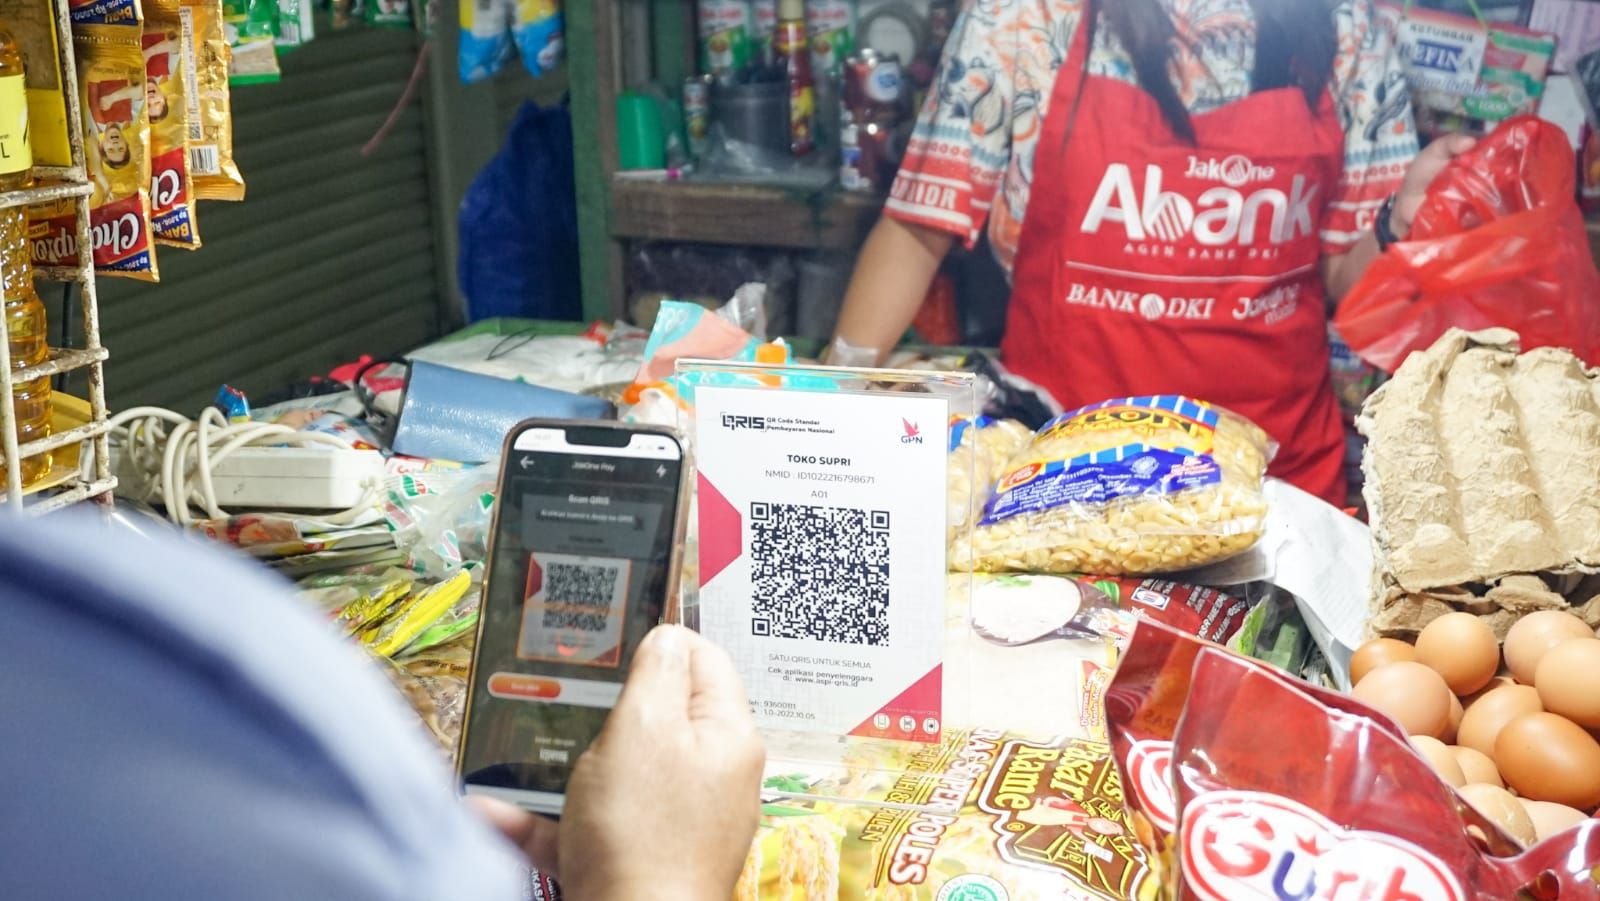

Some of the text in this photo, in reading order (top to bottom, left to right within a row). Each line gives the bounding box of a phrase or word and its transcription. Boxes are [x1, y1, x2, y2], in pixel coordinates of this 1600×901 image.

[1398, 41, 1475, 74] REFINA
[1185, 155, 1275, 187] JakOne
[1080, 162, 1318, 244] Abank
[1188, 245, 1236, 260] BANK
[1248, 246, 1280, 259] DKI
[1066, 281, 1215, 321] BANK DKI
[721, 413, 765, 431] QRIS
[787, 454, 851, 466] TOKO SUPRI
[765, 469, 791, 479] NMID
[768, 653, 872, 669] SATU QRIS UNTUK SEMUA
[784, 668, 814, 677] aplikasi
[816, 671, 873, 683] penyelenggara
[994, 745, 1059, 810] Rame
[888, 812, 957, 885] POLES
